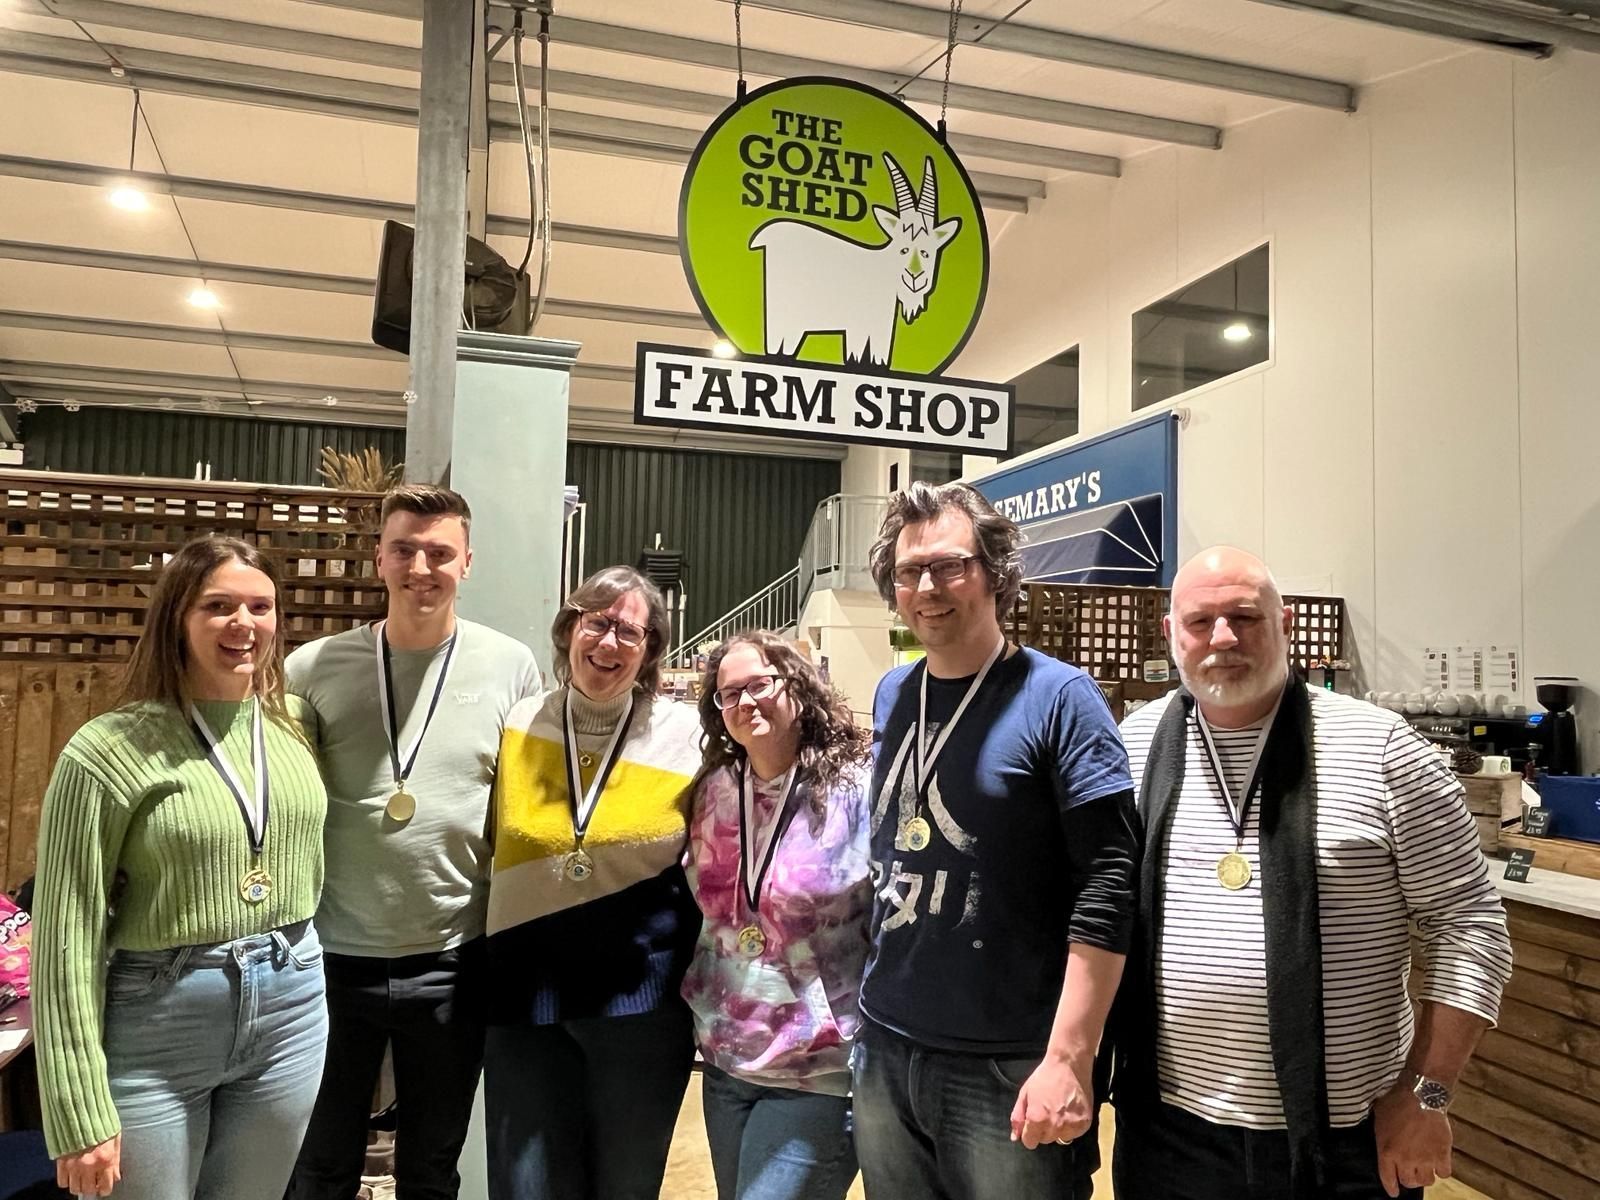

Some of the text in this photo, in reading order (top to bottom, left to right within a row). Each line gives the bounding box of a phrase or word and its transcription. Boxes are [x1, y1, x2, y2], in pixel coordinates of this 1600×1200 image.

[771, 108, 842, 145] THE
[739, 134, 873, 187] GOAT
[741, 173, 868, 222] SHED
[654, 361, 1001, 440] FARM SHOP
